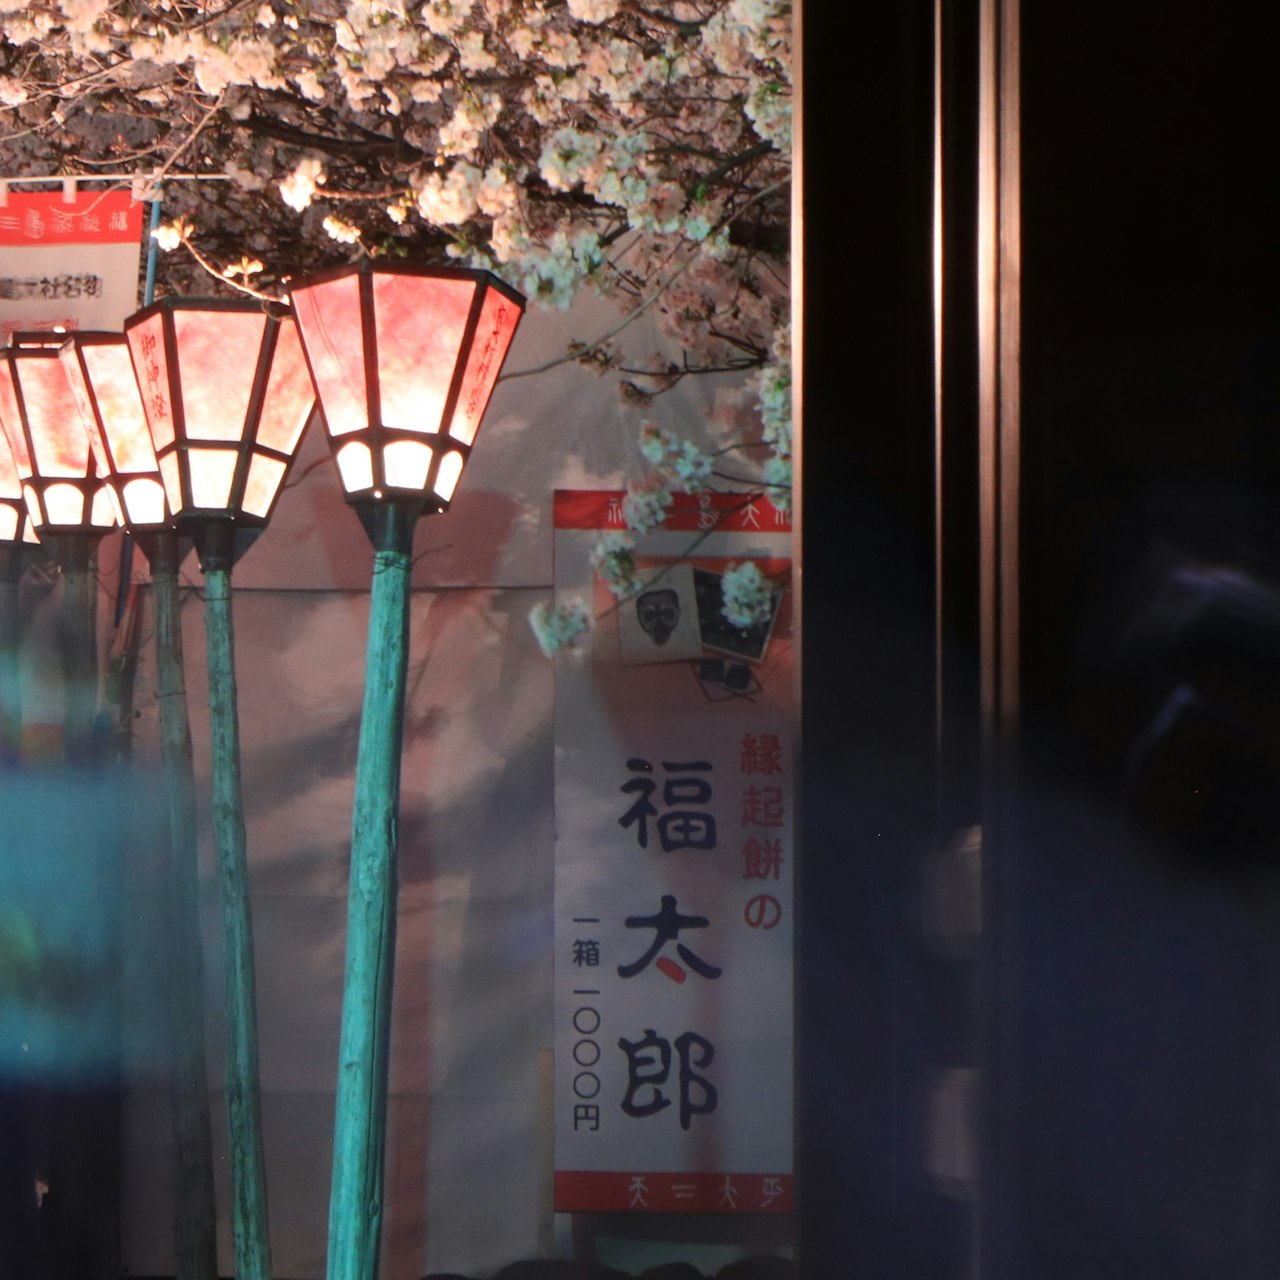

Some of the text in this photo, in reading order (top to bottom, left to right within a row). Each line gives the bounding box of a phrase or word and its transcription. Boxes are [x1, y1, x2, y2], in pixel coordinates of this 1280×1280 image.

[616, 757, 723, 1132] 福太郎
[739, 733, 784, 931] 縁起餅の
